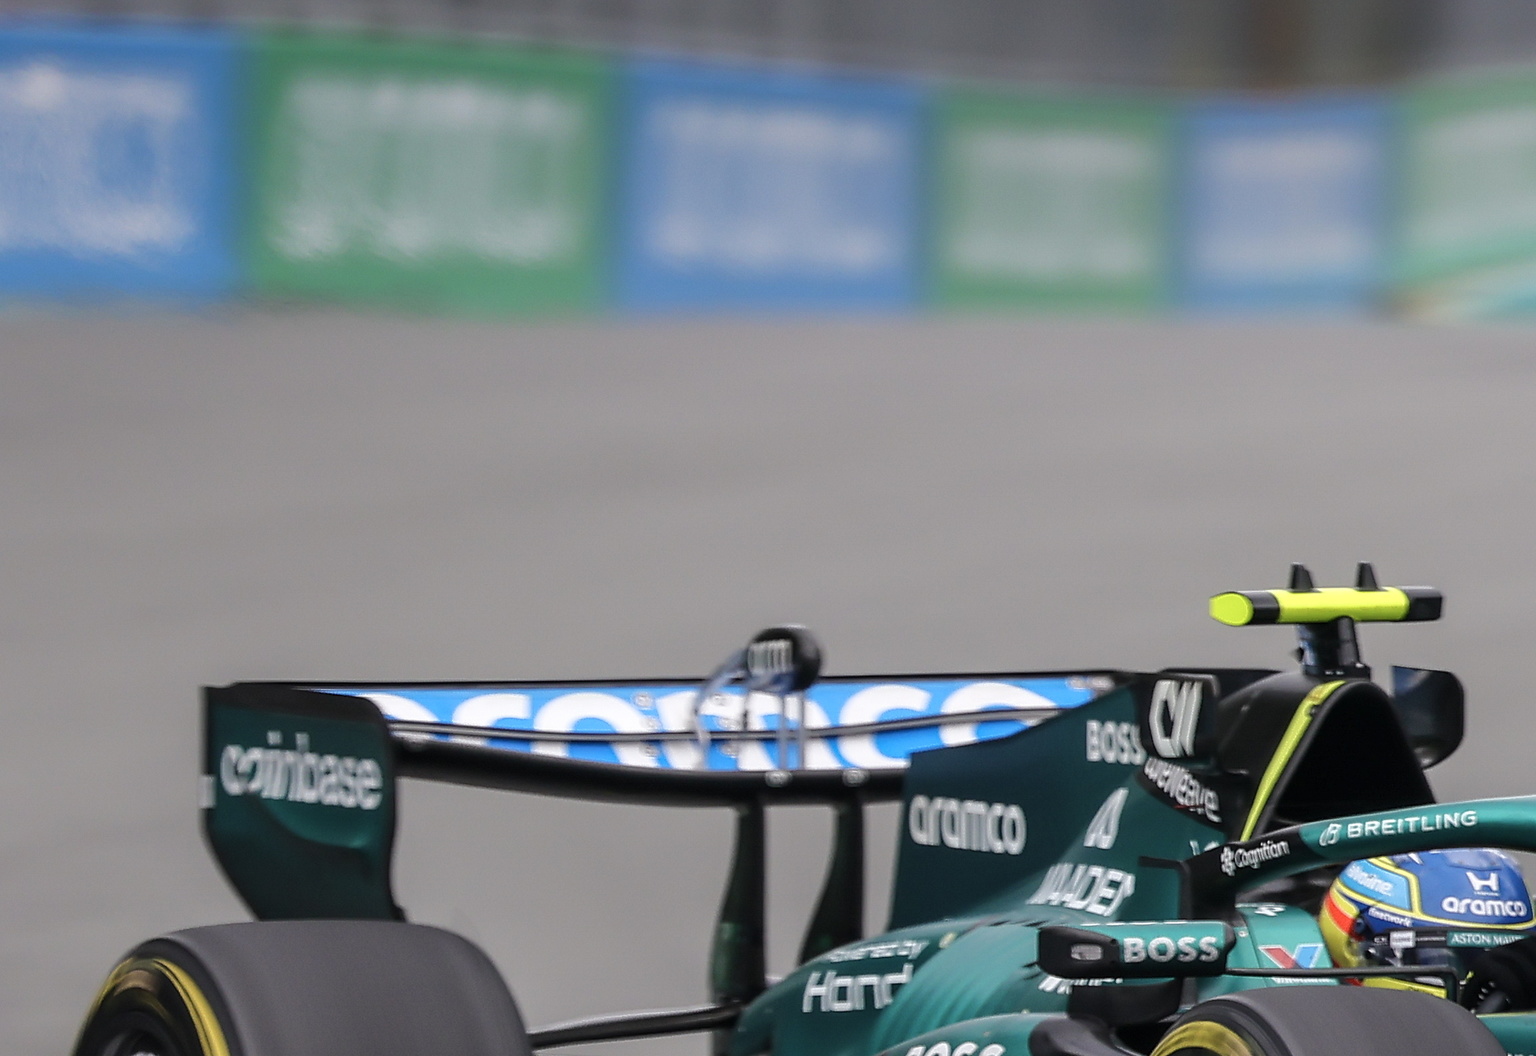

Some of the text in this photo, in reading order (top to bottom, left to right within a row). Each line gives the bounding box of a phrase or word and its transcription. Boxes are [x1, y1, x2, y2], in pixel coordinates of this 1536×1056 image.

[366, 684, 1060, 771] ramco
[1086, 718, 1147, 765] BOSS
[220, 730, 383, 810] coinbase
[908, 795, 1026, 855] aramco
[1347, 810, 1478, 838] BREITLING
[1234, 840, 1290, 869] Cognition
[1441, 897, 1527, 917] aramco
[1123, 936, 1220, 963] BOSS
[1451, 933, 1490, 944] ASTON
[802, 963, 914, 1013] Hond
